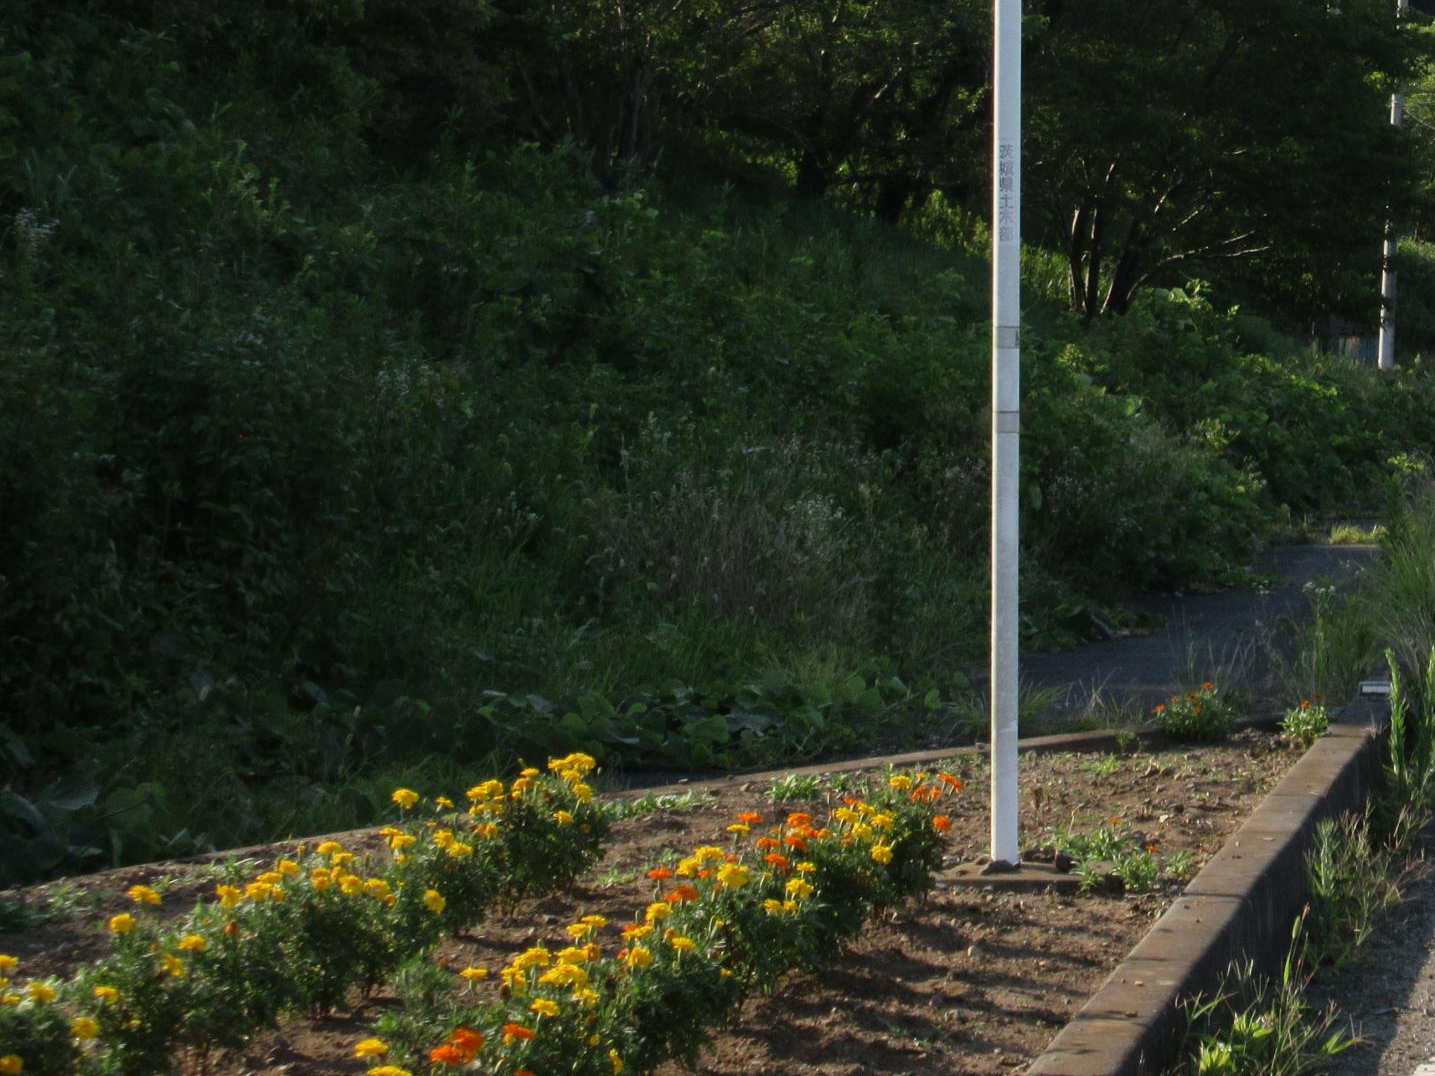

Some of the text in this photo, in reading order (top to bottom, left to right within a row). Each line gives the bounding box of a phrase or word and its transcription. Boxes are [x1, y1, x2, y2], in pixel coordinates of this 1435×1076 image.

[999, 143, 1014, 242] 茨城県土木部
